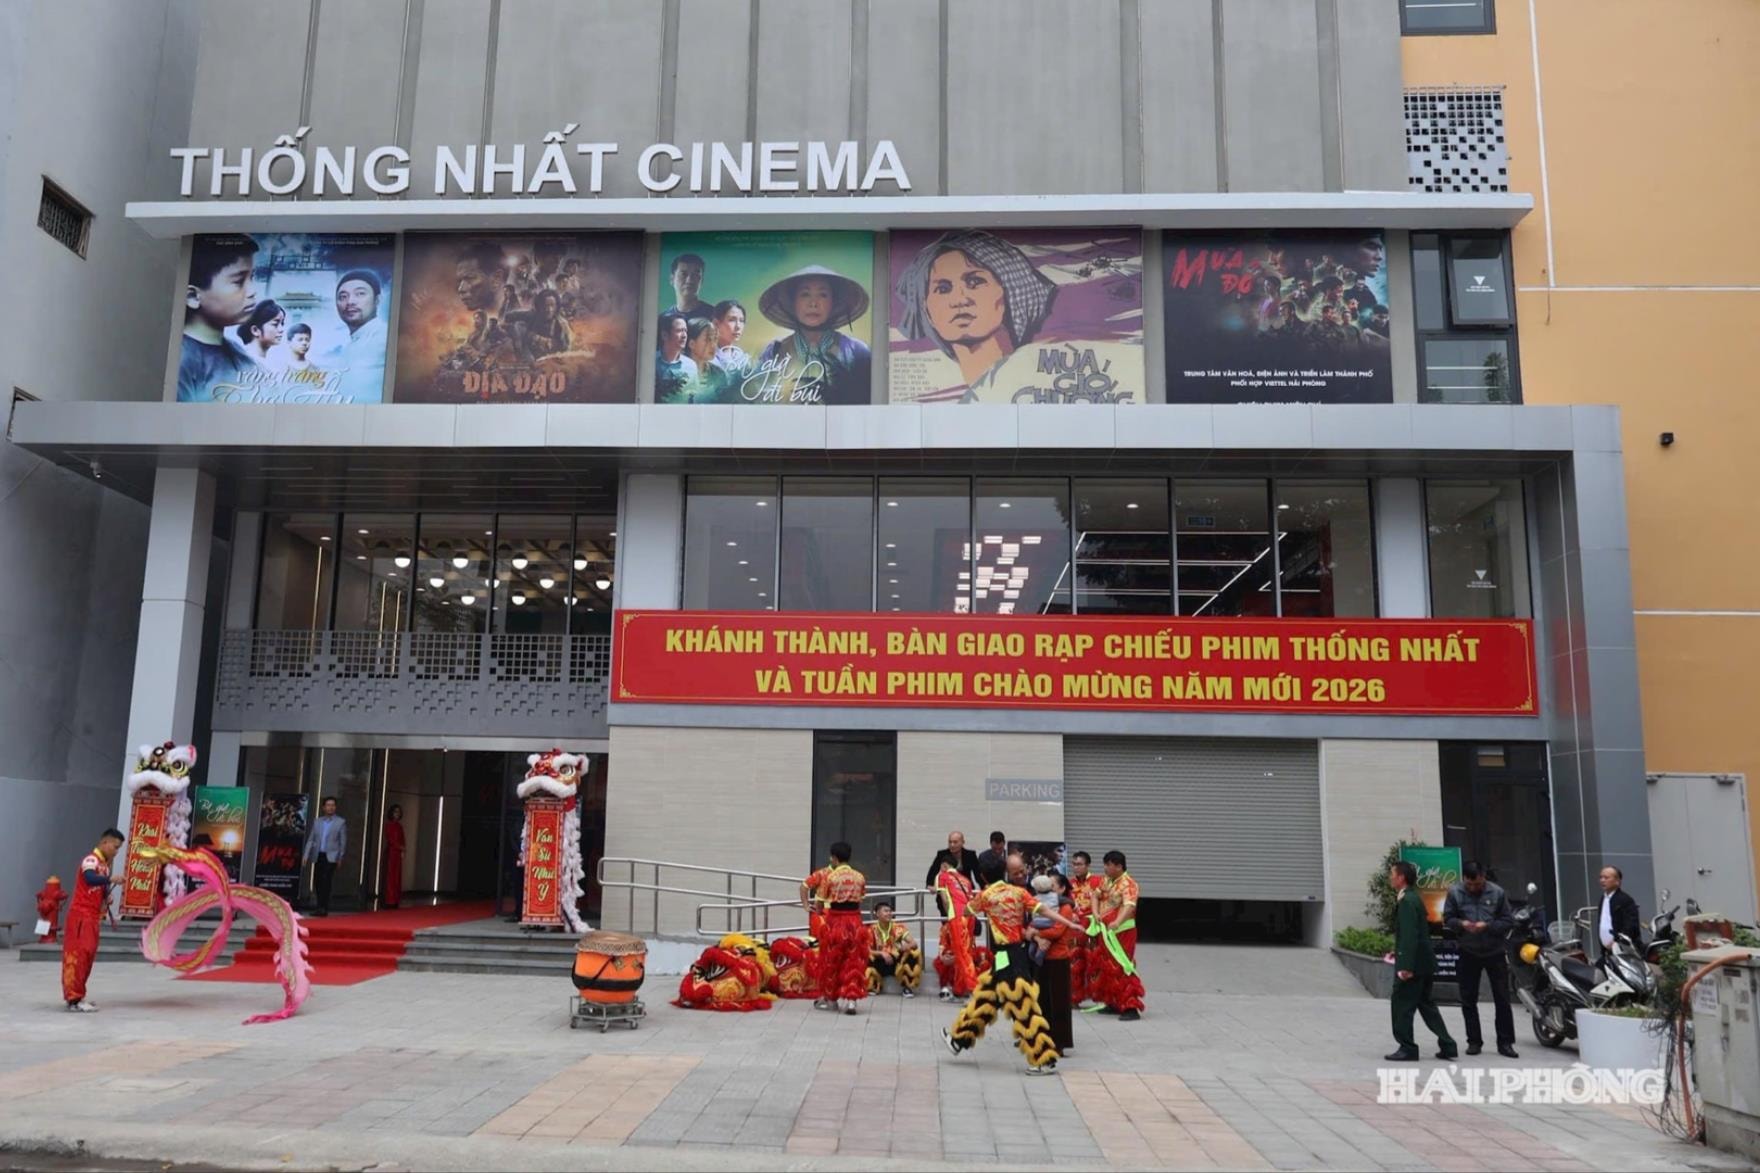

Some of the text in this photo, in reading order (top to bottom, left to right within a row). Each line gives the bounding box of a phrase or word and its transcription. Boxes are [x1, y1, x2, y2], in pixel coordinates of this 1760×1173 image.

[170, 123, 912, 195] THỐNG NHẤT CINEMA
[1037, 343, 1100, 374] MÙA
[665, 625, 1481, 662] KHÁNH THÀNH, BÀN GIAO RẠP CHIẾU PHIM THỐNG NHẤT
[755, 663, 1386, 702] VÀ TUẦN PHIM CHÀO MỪNG NĂM MỚI 2026
[990, 783, 1061, 798] PARKING
